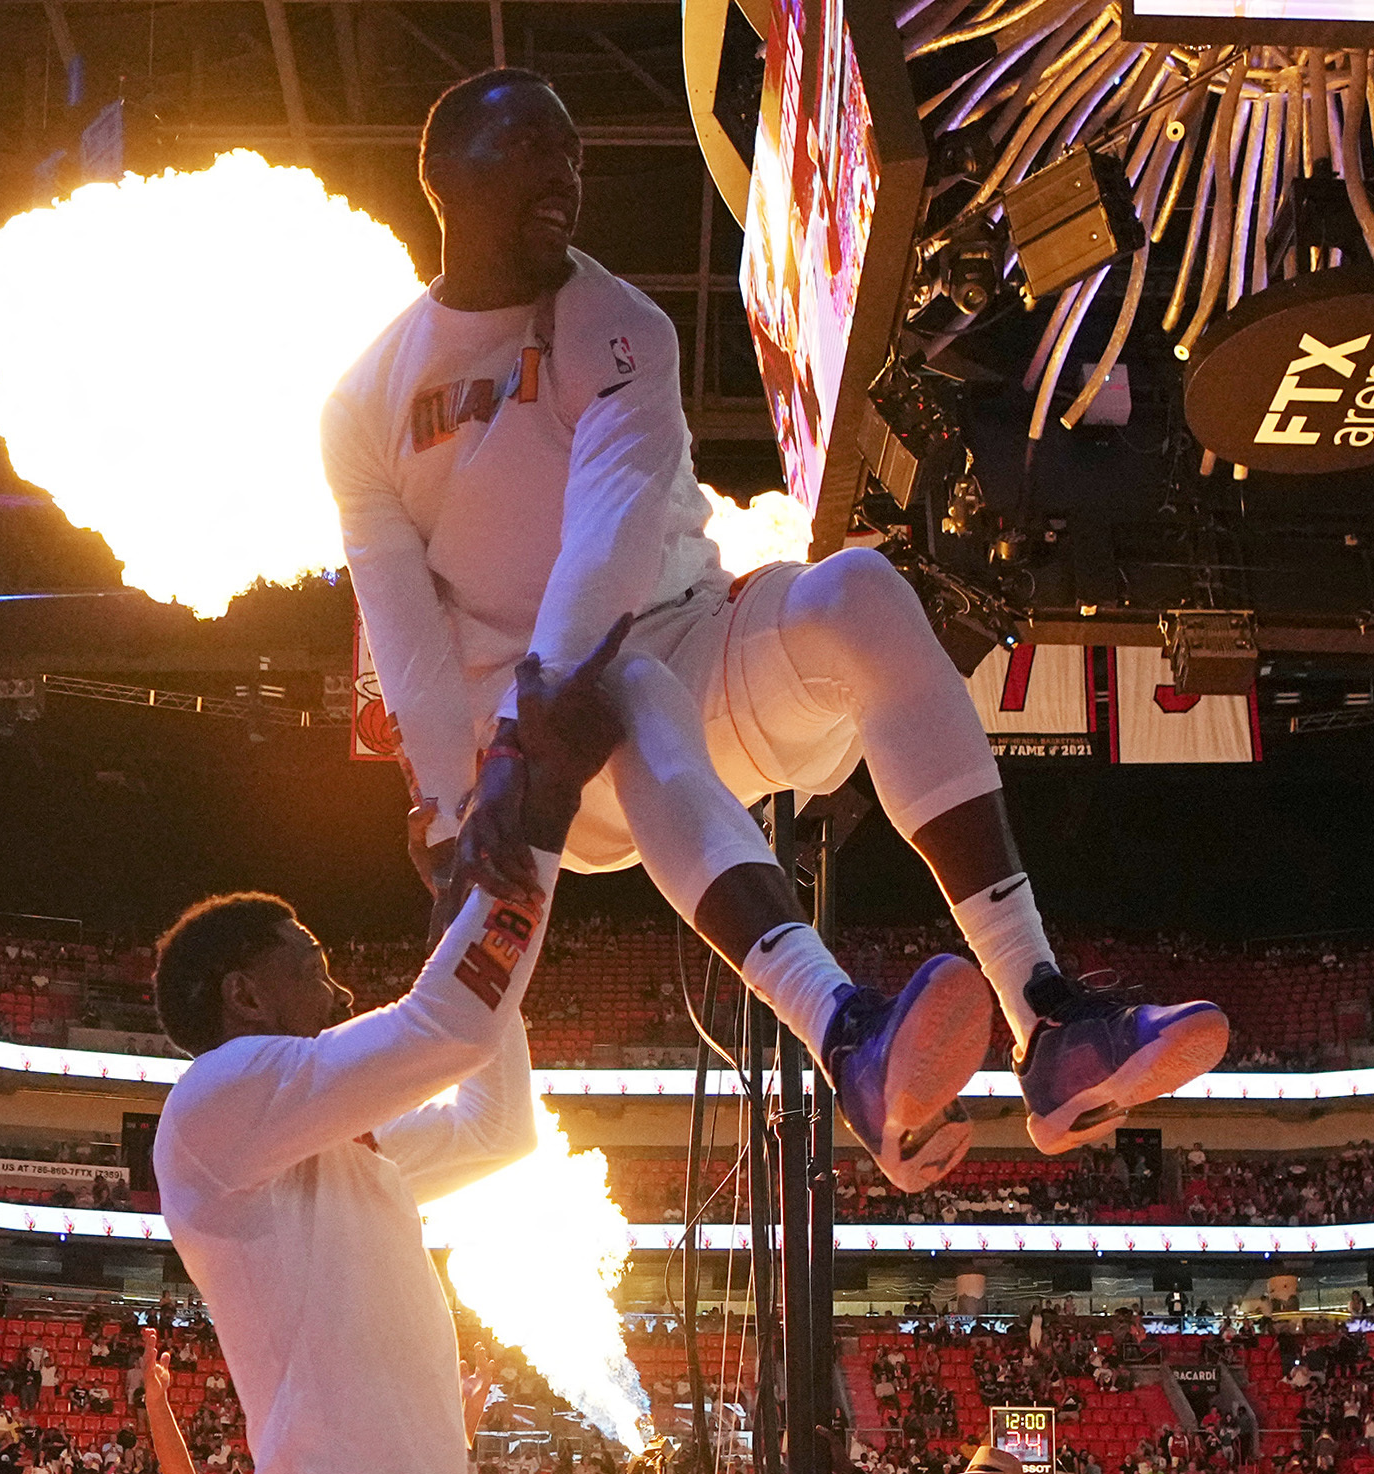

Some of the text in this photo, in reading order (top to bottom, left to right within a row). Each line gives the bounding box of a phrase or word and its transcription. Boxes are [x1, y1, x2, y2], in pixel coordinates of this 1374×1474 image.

[1254, 333, 1372, 445] FTX
[1010, 745, 1046, 756] FAME
[1061, 745, 1093, 756] 2021
[2, 1163, 15, 1172] US
[17, 1164, 30, 1173] AT
[1005, 1413, 1046, 1430] 12:00
[1006, 1431, 1041, 1457] 24
